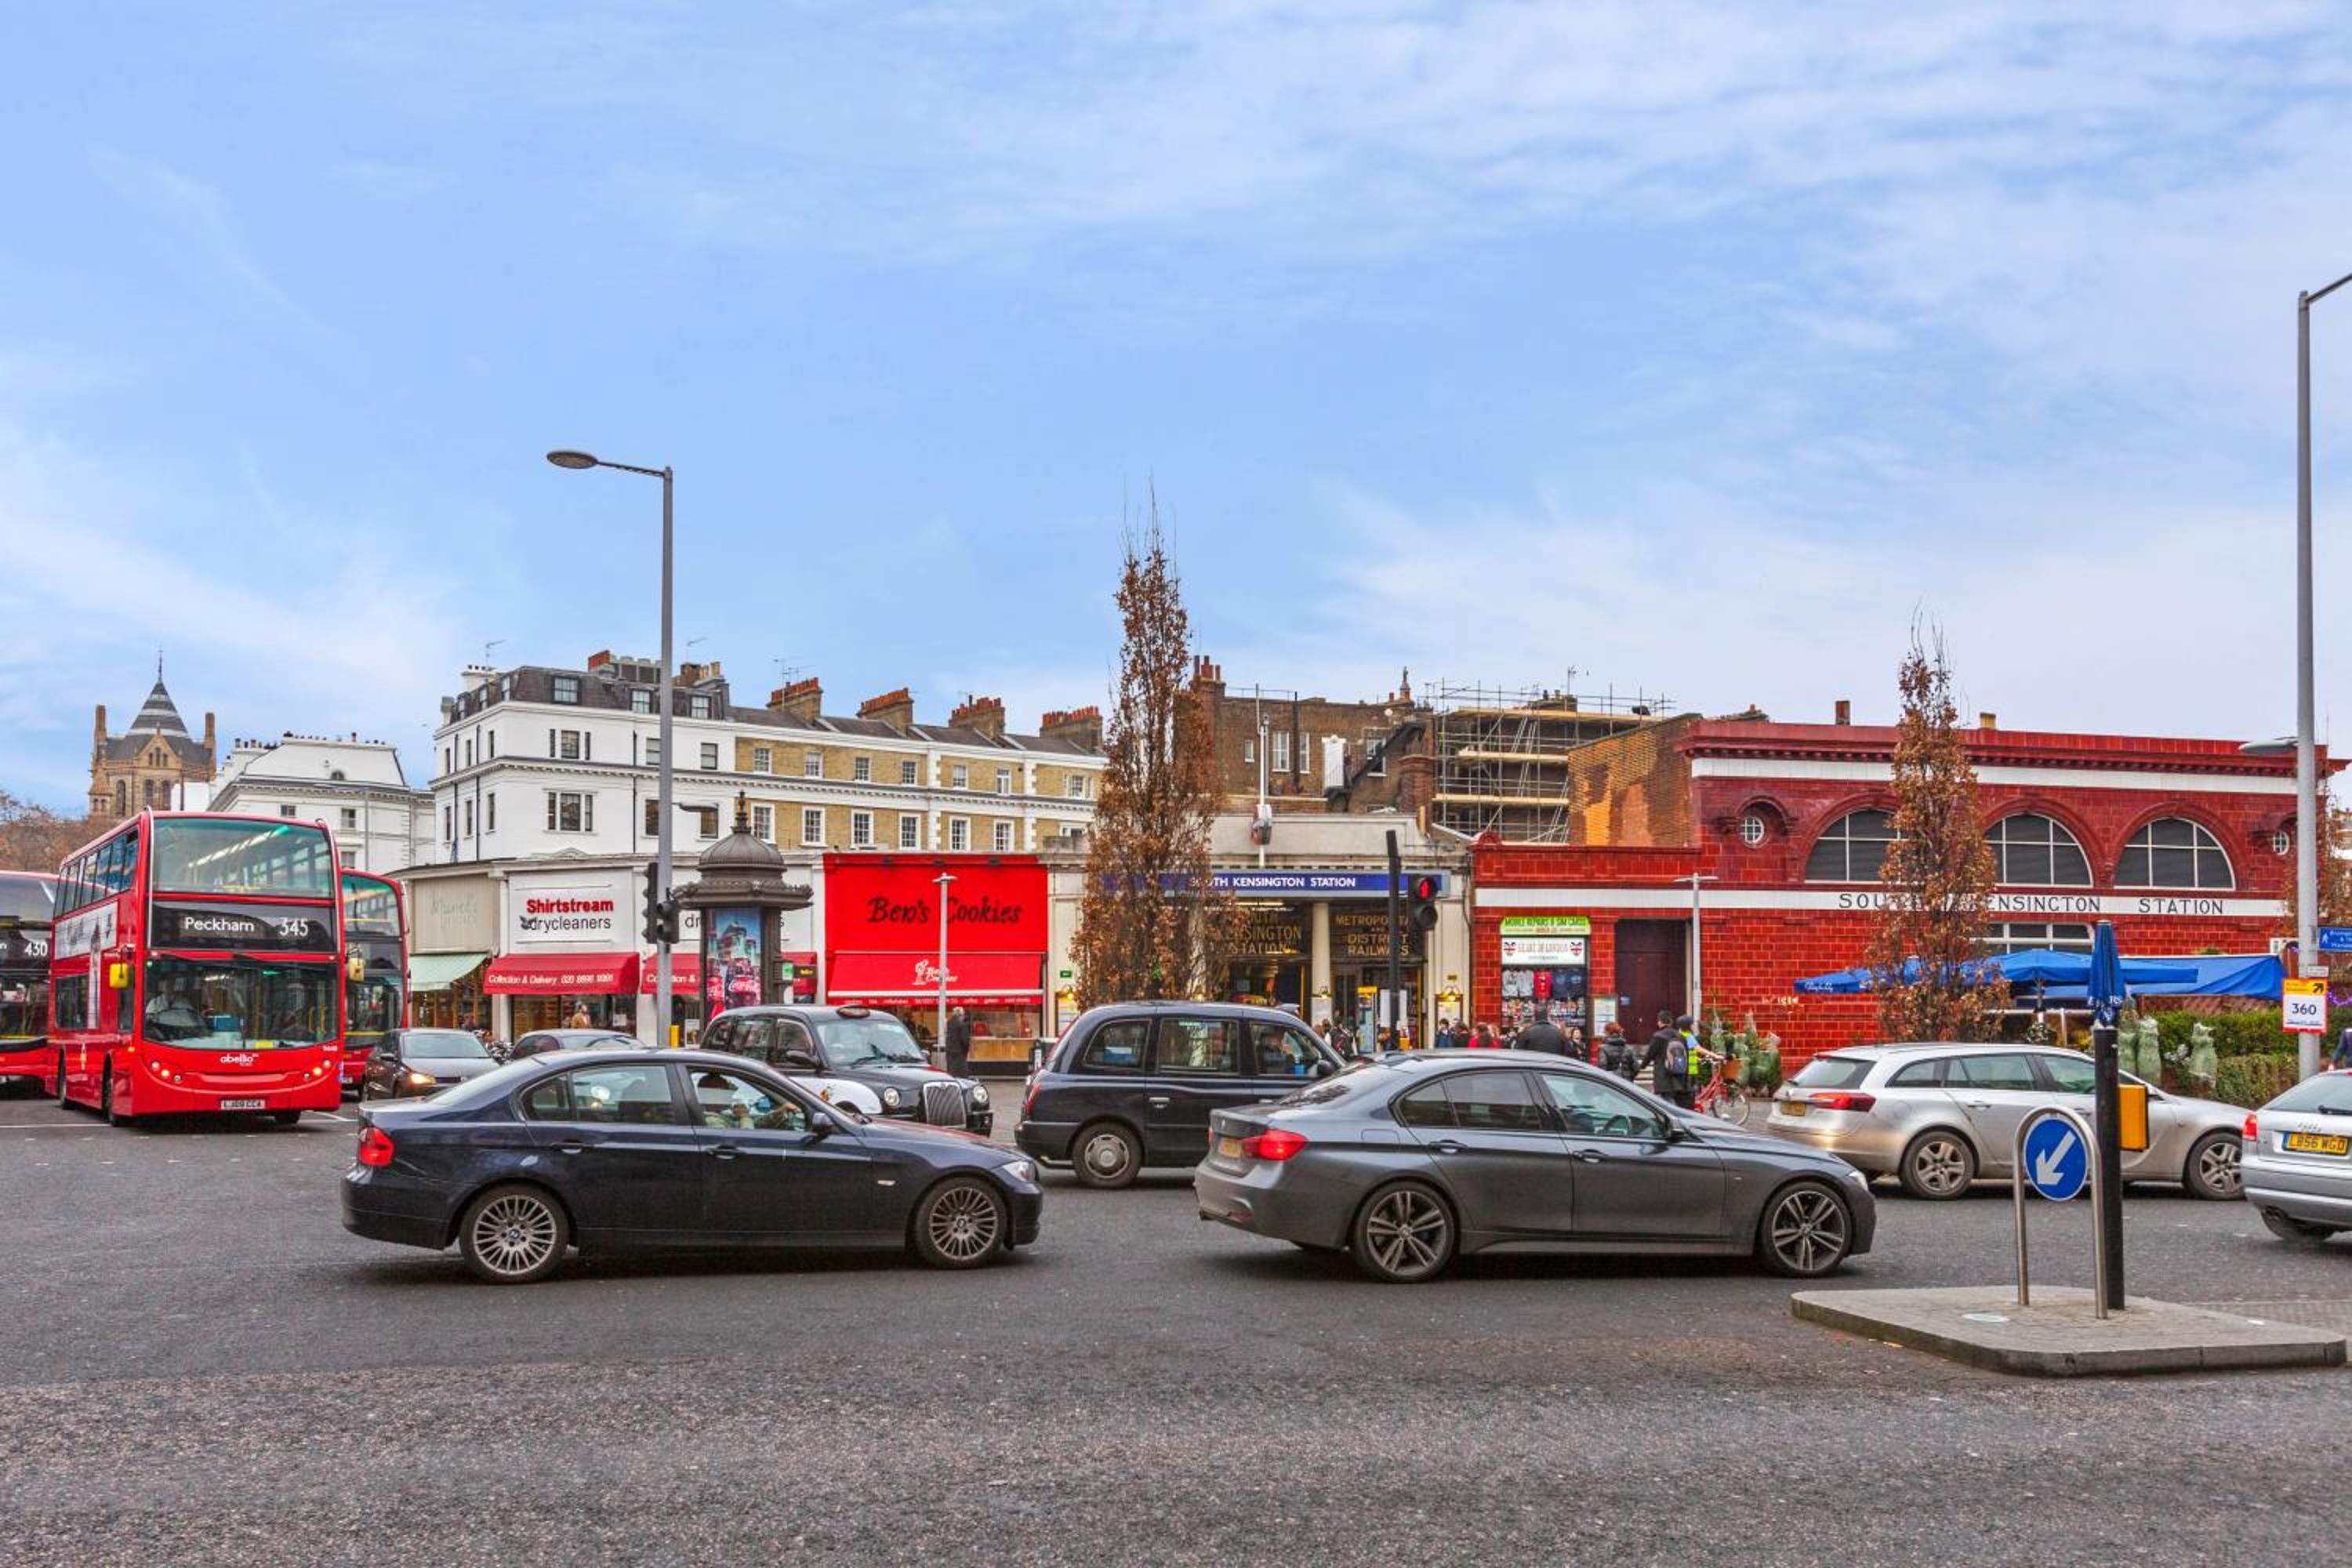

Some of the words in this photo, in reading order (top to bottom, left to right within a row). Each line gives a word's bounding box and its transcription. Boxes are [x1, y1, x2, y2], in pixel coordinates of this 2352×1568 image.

[1232, 877, 1305, 887] KENSINGTON
[1310, 877, 1356, 887] STATION
[526, 898, 614, 913] Shirtstream
[867, 896, 930, 924] Ben's
[2138, 898, 2223, 914] STATION
[185, 916, 255, 932] Peckham
[279, 916, 309, 936] 345
[528, 916, 612, 933] drycleaners
[24, 941, 48, 956] 430
[488, 975, 521, 984] Collection
[530, 975, 557, 985] Delivery
[2292, 1004, 2318, 1015] 360
[220, 1053, 254, 1064] abellio
